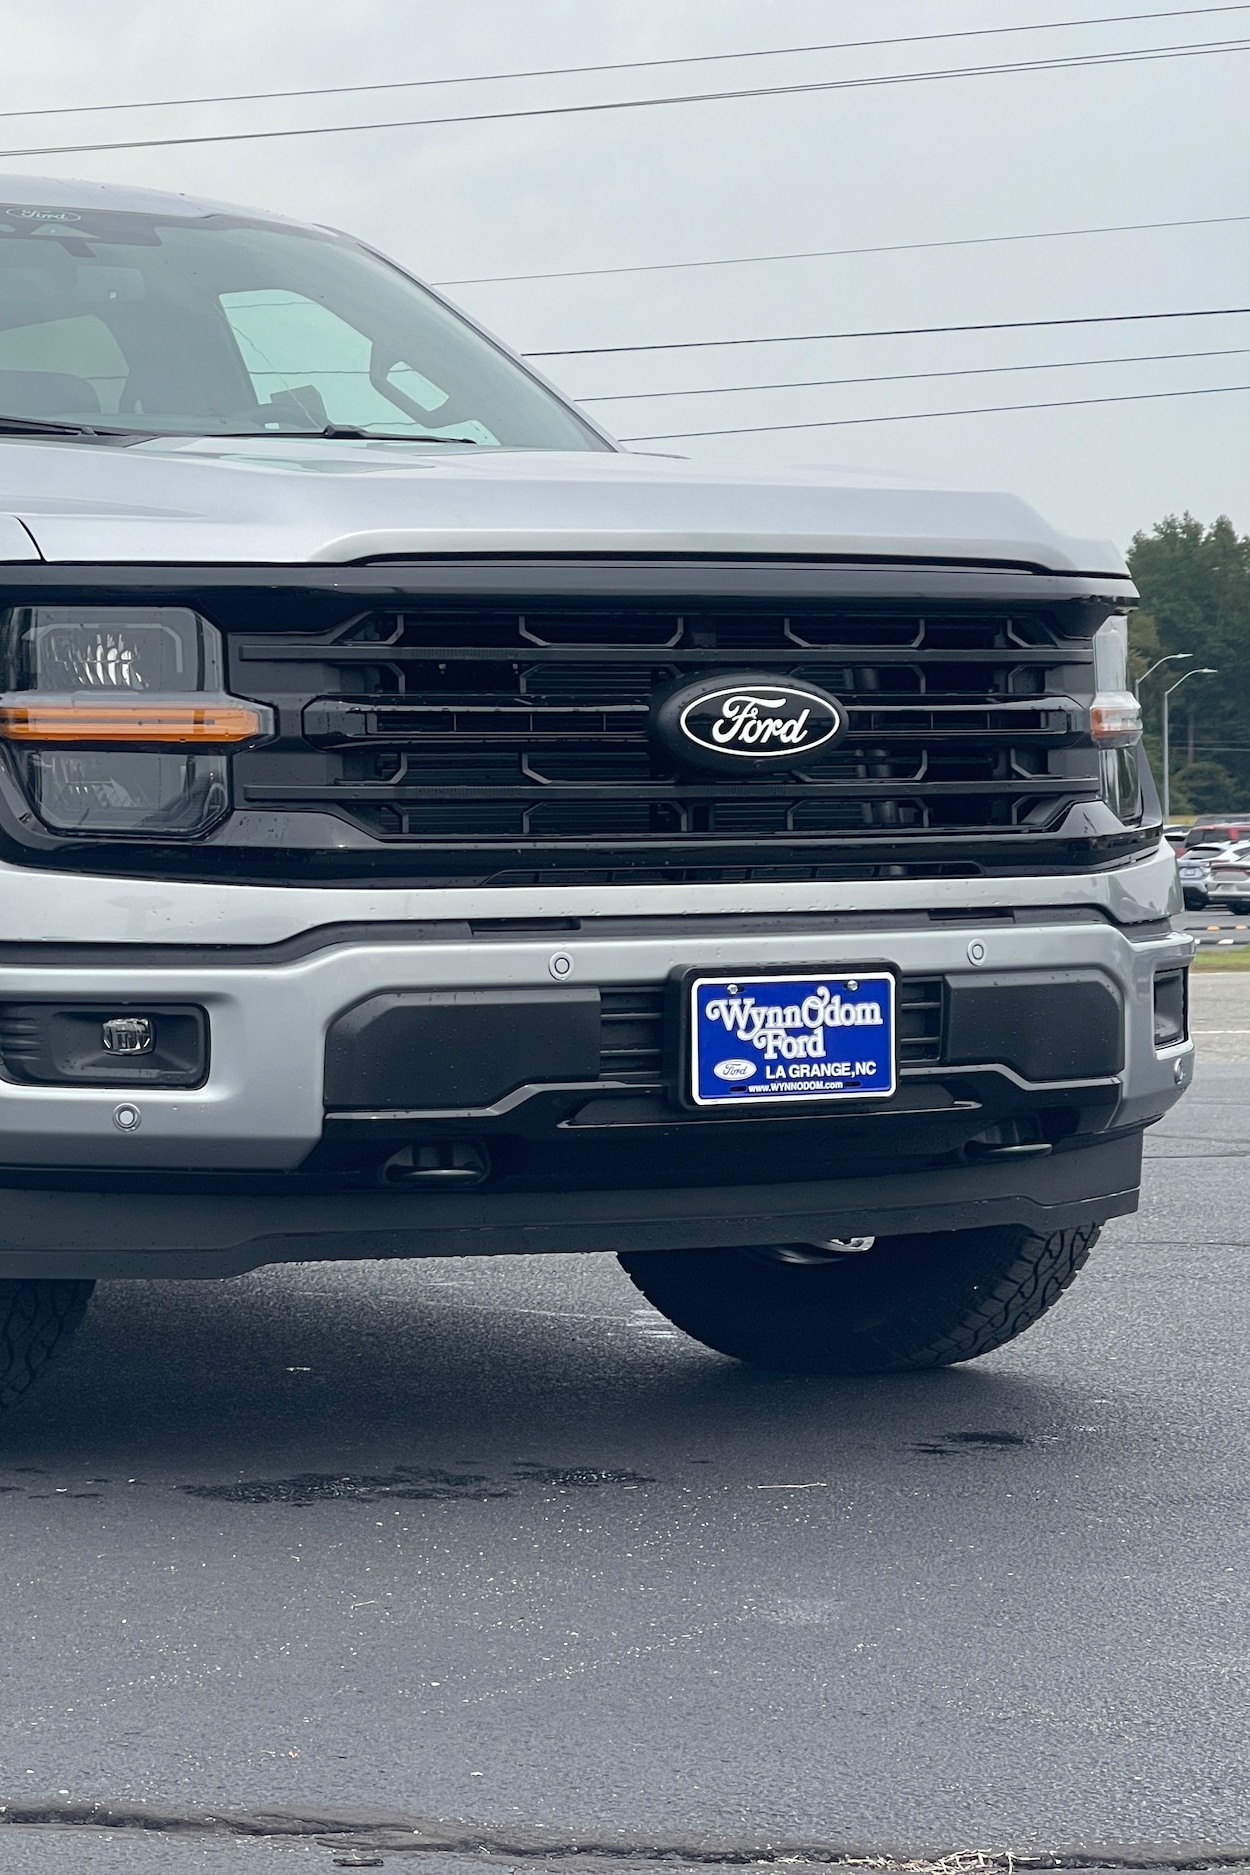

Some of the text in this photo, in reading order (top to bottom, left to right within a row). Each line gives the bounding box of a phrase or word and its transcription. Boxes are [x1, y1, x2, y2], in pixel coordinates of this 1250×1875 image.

[21, 207, 69, 221] Ford
[711, 695, 811, 744] Ford
[752, 1026, 827, 1060] Ford
[765, 1064, 786, 1080] LA
[748, 1080, 844, 1093] www.WYNNODOM.com
